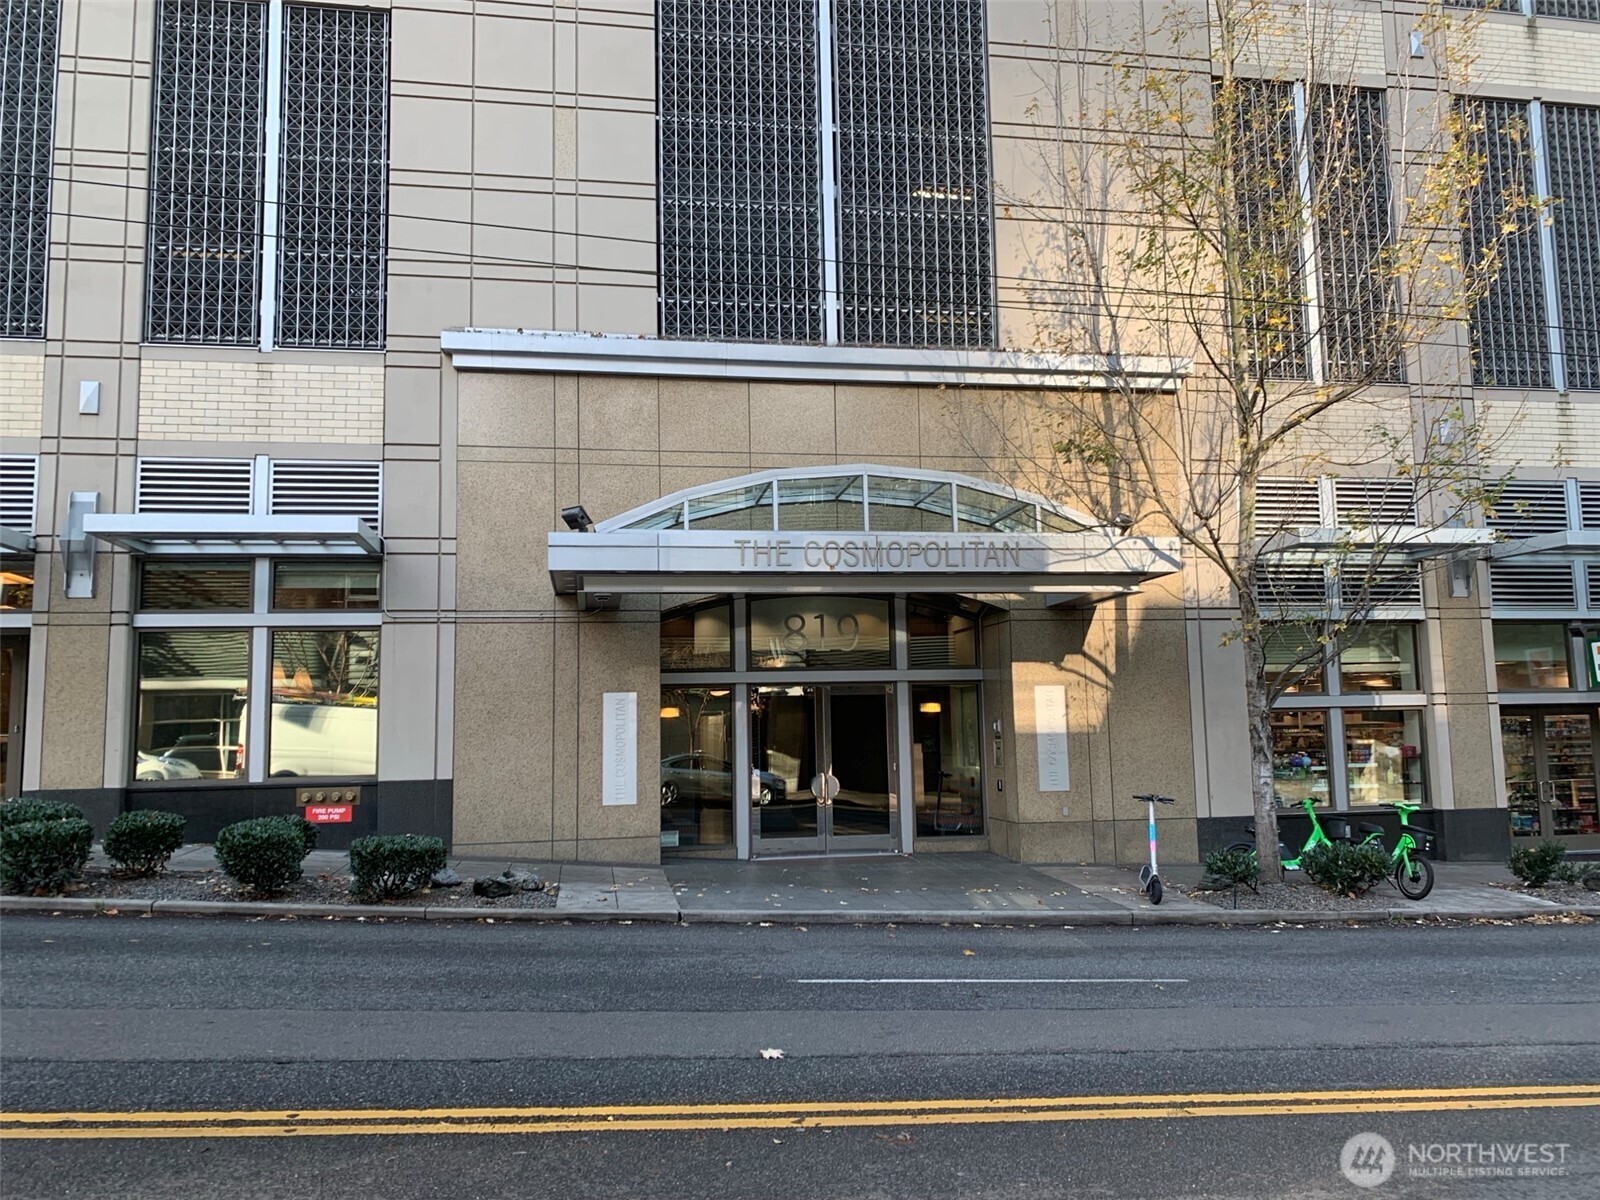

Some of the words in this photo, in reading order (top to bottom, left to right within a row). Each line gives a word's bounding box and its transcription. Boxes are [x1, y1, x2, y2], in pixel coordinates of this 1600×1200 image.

[734, 539, 792, 568] THE
[803, 539, 1021, 569] COSMOPOLITAN
[782, 612, 860, 652] 819
[614, 697, 626, 778] COSMOPOLITAN
